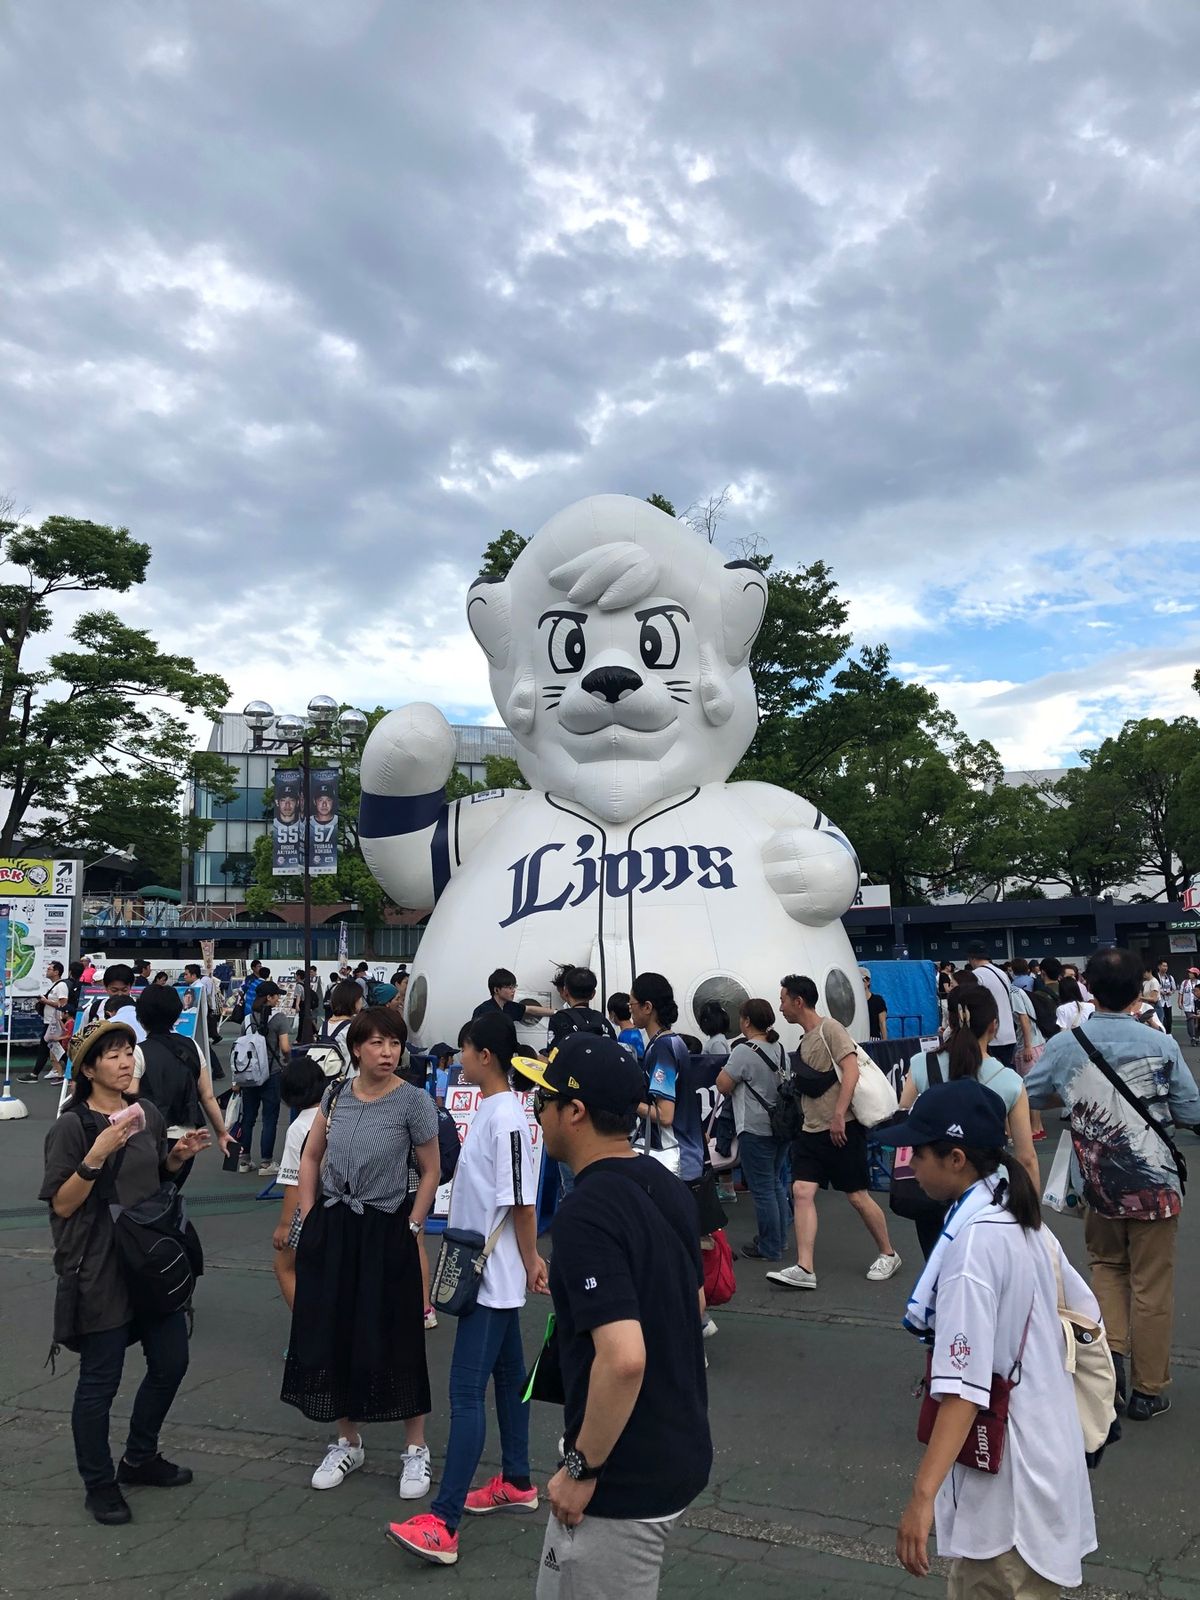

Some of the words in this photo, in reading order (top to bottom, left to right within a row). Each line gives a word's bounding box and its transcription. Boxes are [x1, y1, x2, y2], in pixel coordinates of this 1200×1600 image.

[277, 826, 298, 843] 55
[314, 825, 334, 842] 57
[56, 883, 72, 894] 2F
[498, 834, 737, 928] Lions
[376, 971, 385, 981] 17
[444, 1247, 460, 1287] NORTH
[450, 1266, 462, 1288] THE
[584, 1276, 598, 1290] JB
[974, 1424, 991, 1471] Lions
[544, 1559, 561, 1572] adidas
